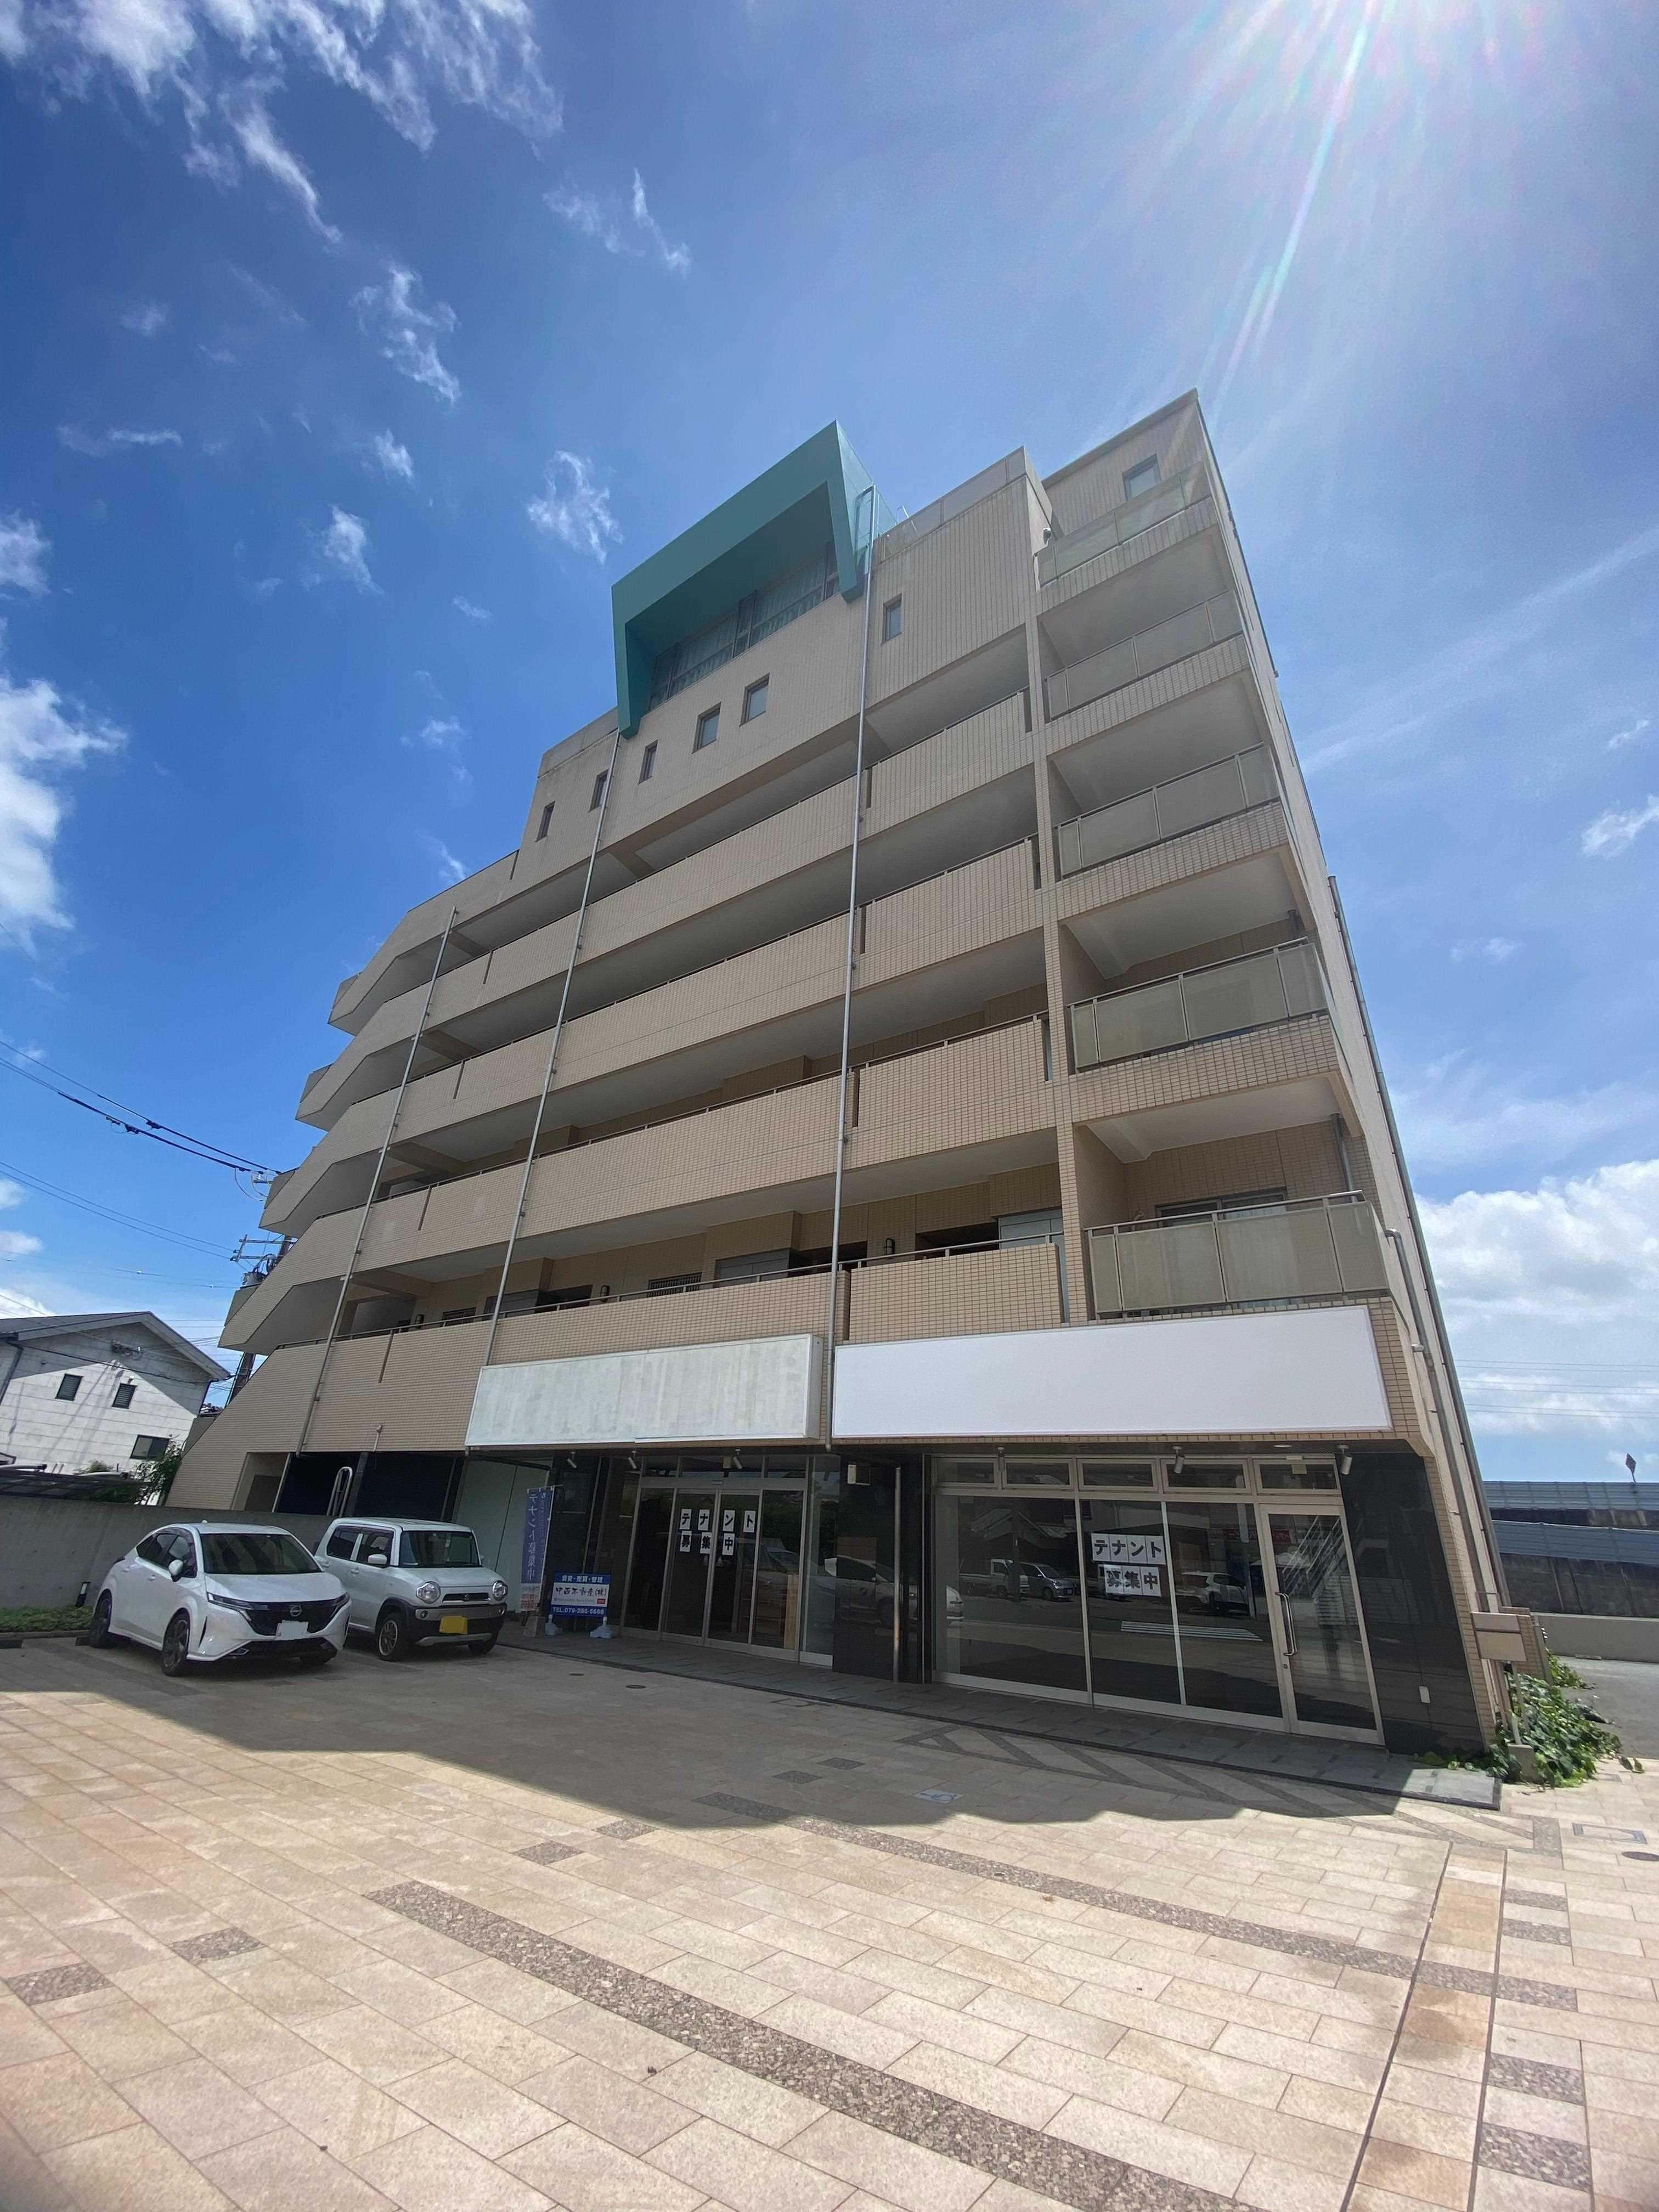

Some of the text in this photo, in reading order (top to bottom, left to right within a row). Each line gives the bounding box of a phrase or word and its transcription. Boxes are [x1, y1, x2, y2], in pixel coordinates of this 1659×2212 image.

[682, 1513, 753, 1527] テナント
[682, 1534, 733, 1550] 募集中
[1094, 1539, 1161, 1558] テナント
[1106, 1570, 1158, 1589] 募集中
